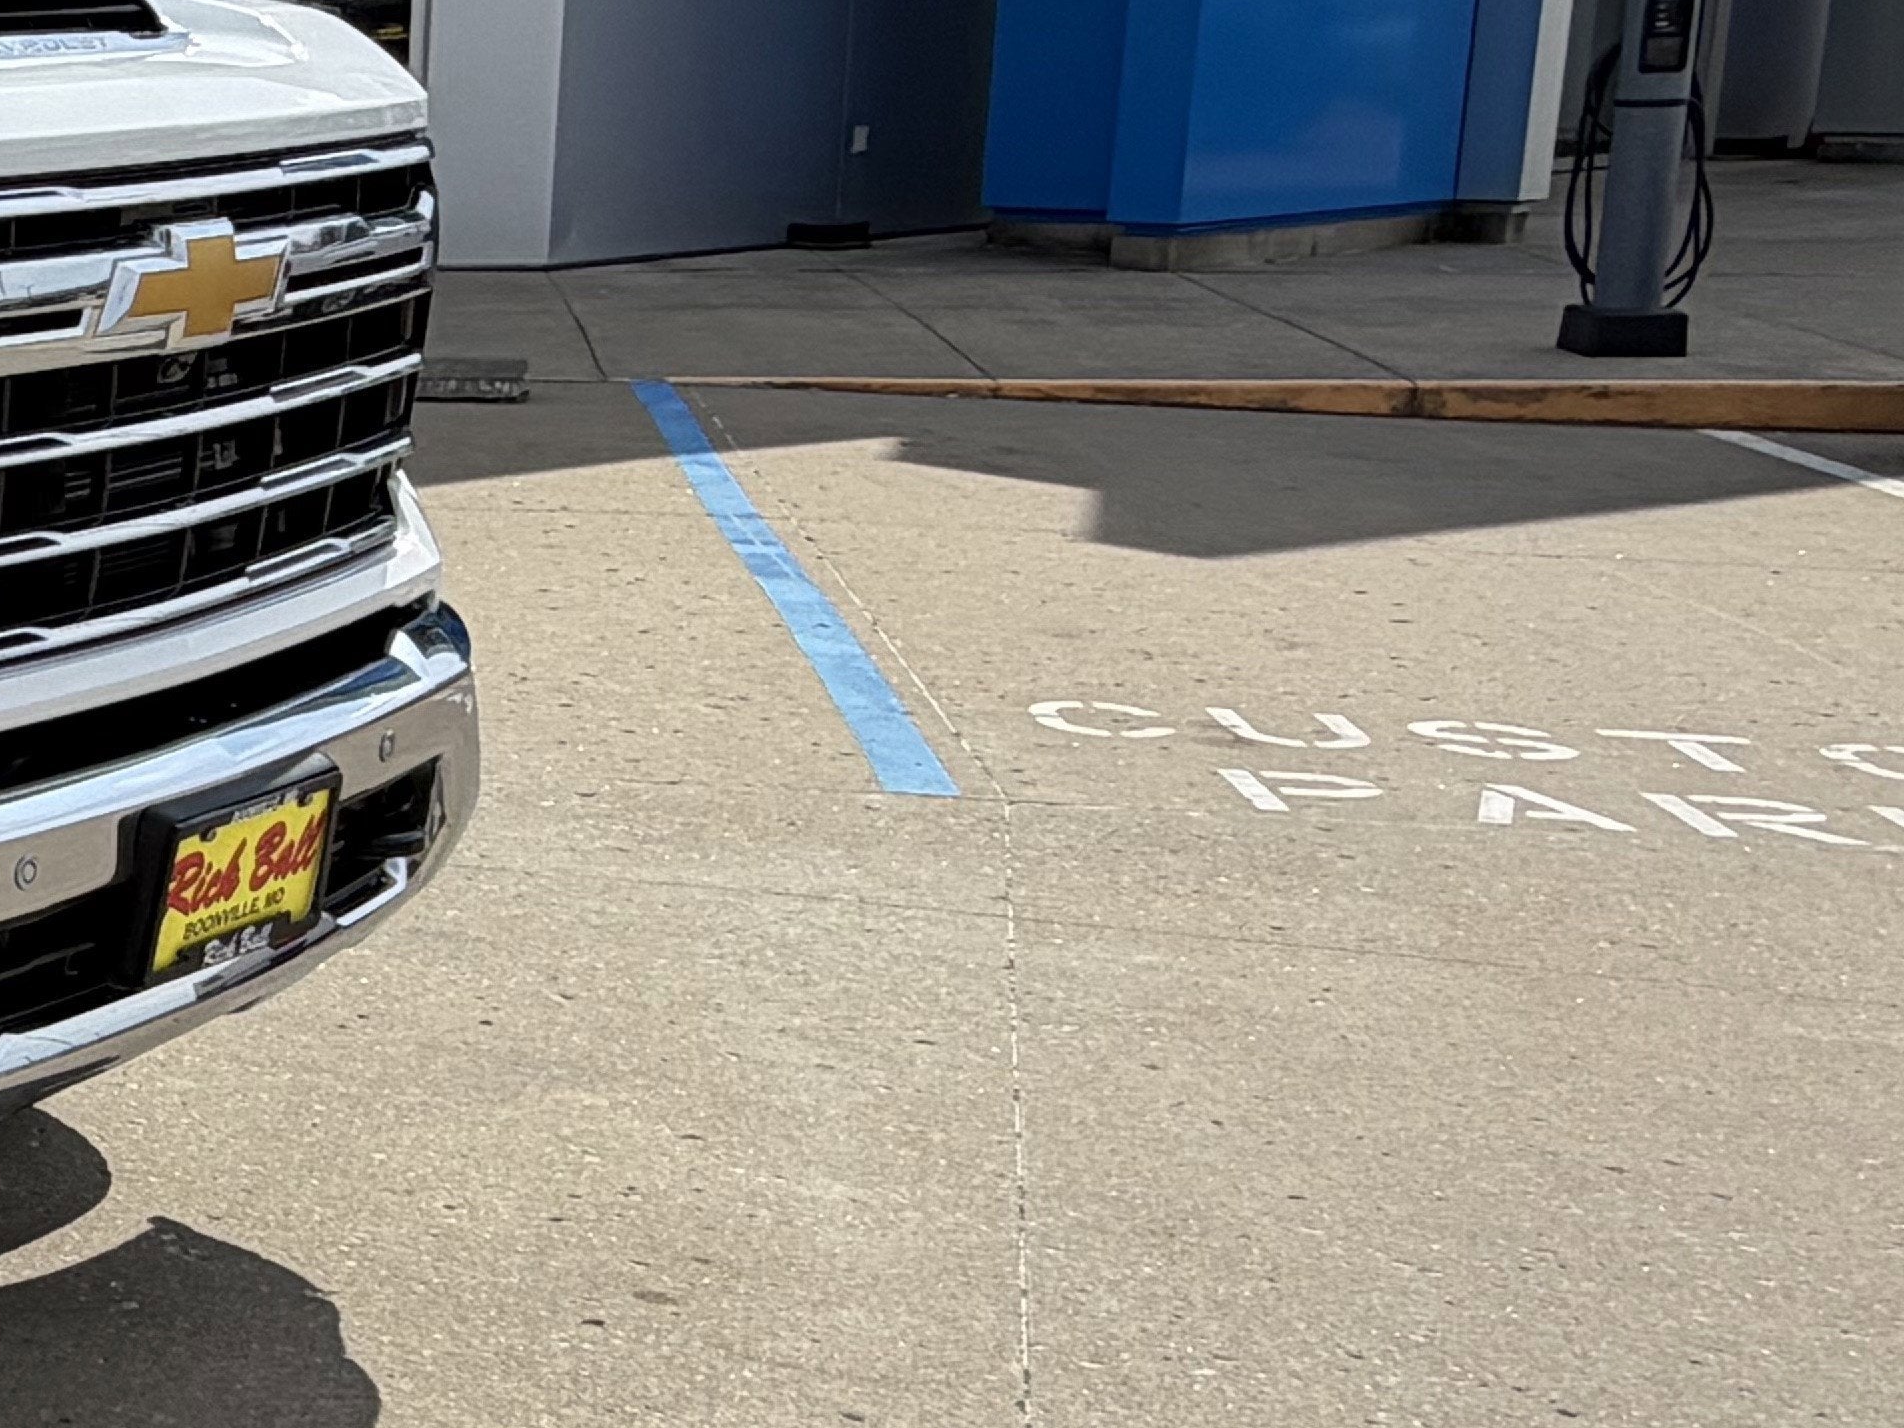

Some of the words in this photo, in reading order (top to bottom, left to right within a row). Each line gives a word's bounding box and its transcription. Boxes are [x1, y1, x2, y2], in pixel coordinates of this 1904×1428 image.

[1218, 767, 1904, 847] PAR
[167, 836, 247, 916] Rick
[249, 809, 328, 892] Ball
